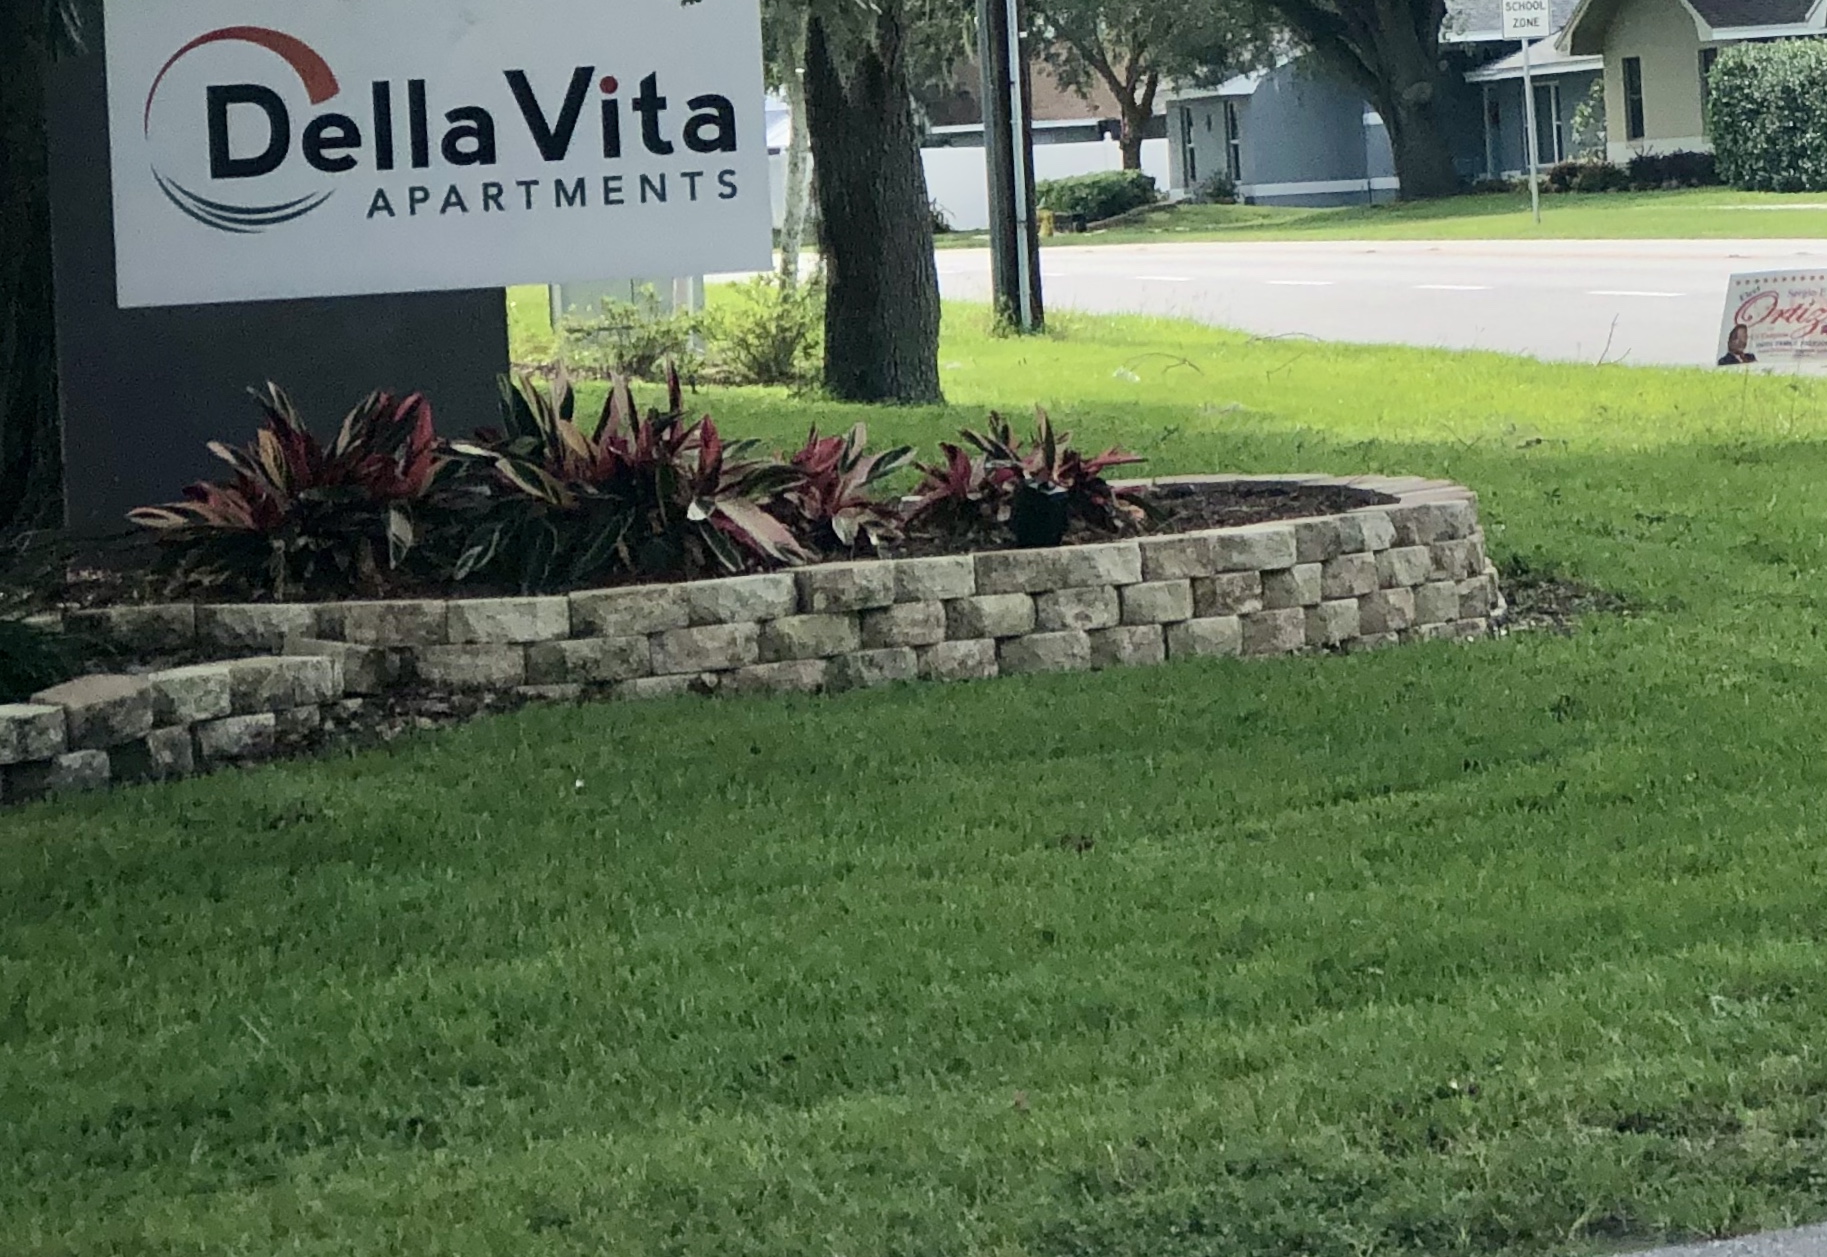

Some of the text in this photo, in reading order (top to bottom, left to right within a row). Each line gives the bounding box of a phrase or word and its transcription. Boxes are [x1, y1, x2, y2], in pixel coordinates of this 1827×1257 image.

[1505, 1, 1546, 11] SCHOOL
[1513, 17, 1540, 28] ZONE
[204, 65, 739, 180] DellaVita
[366, 168, 739, 220] APARTMENTS
